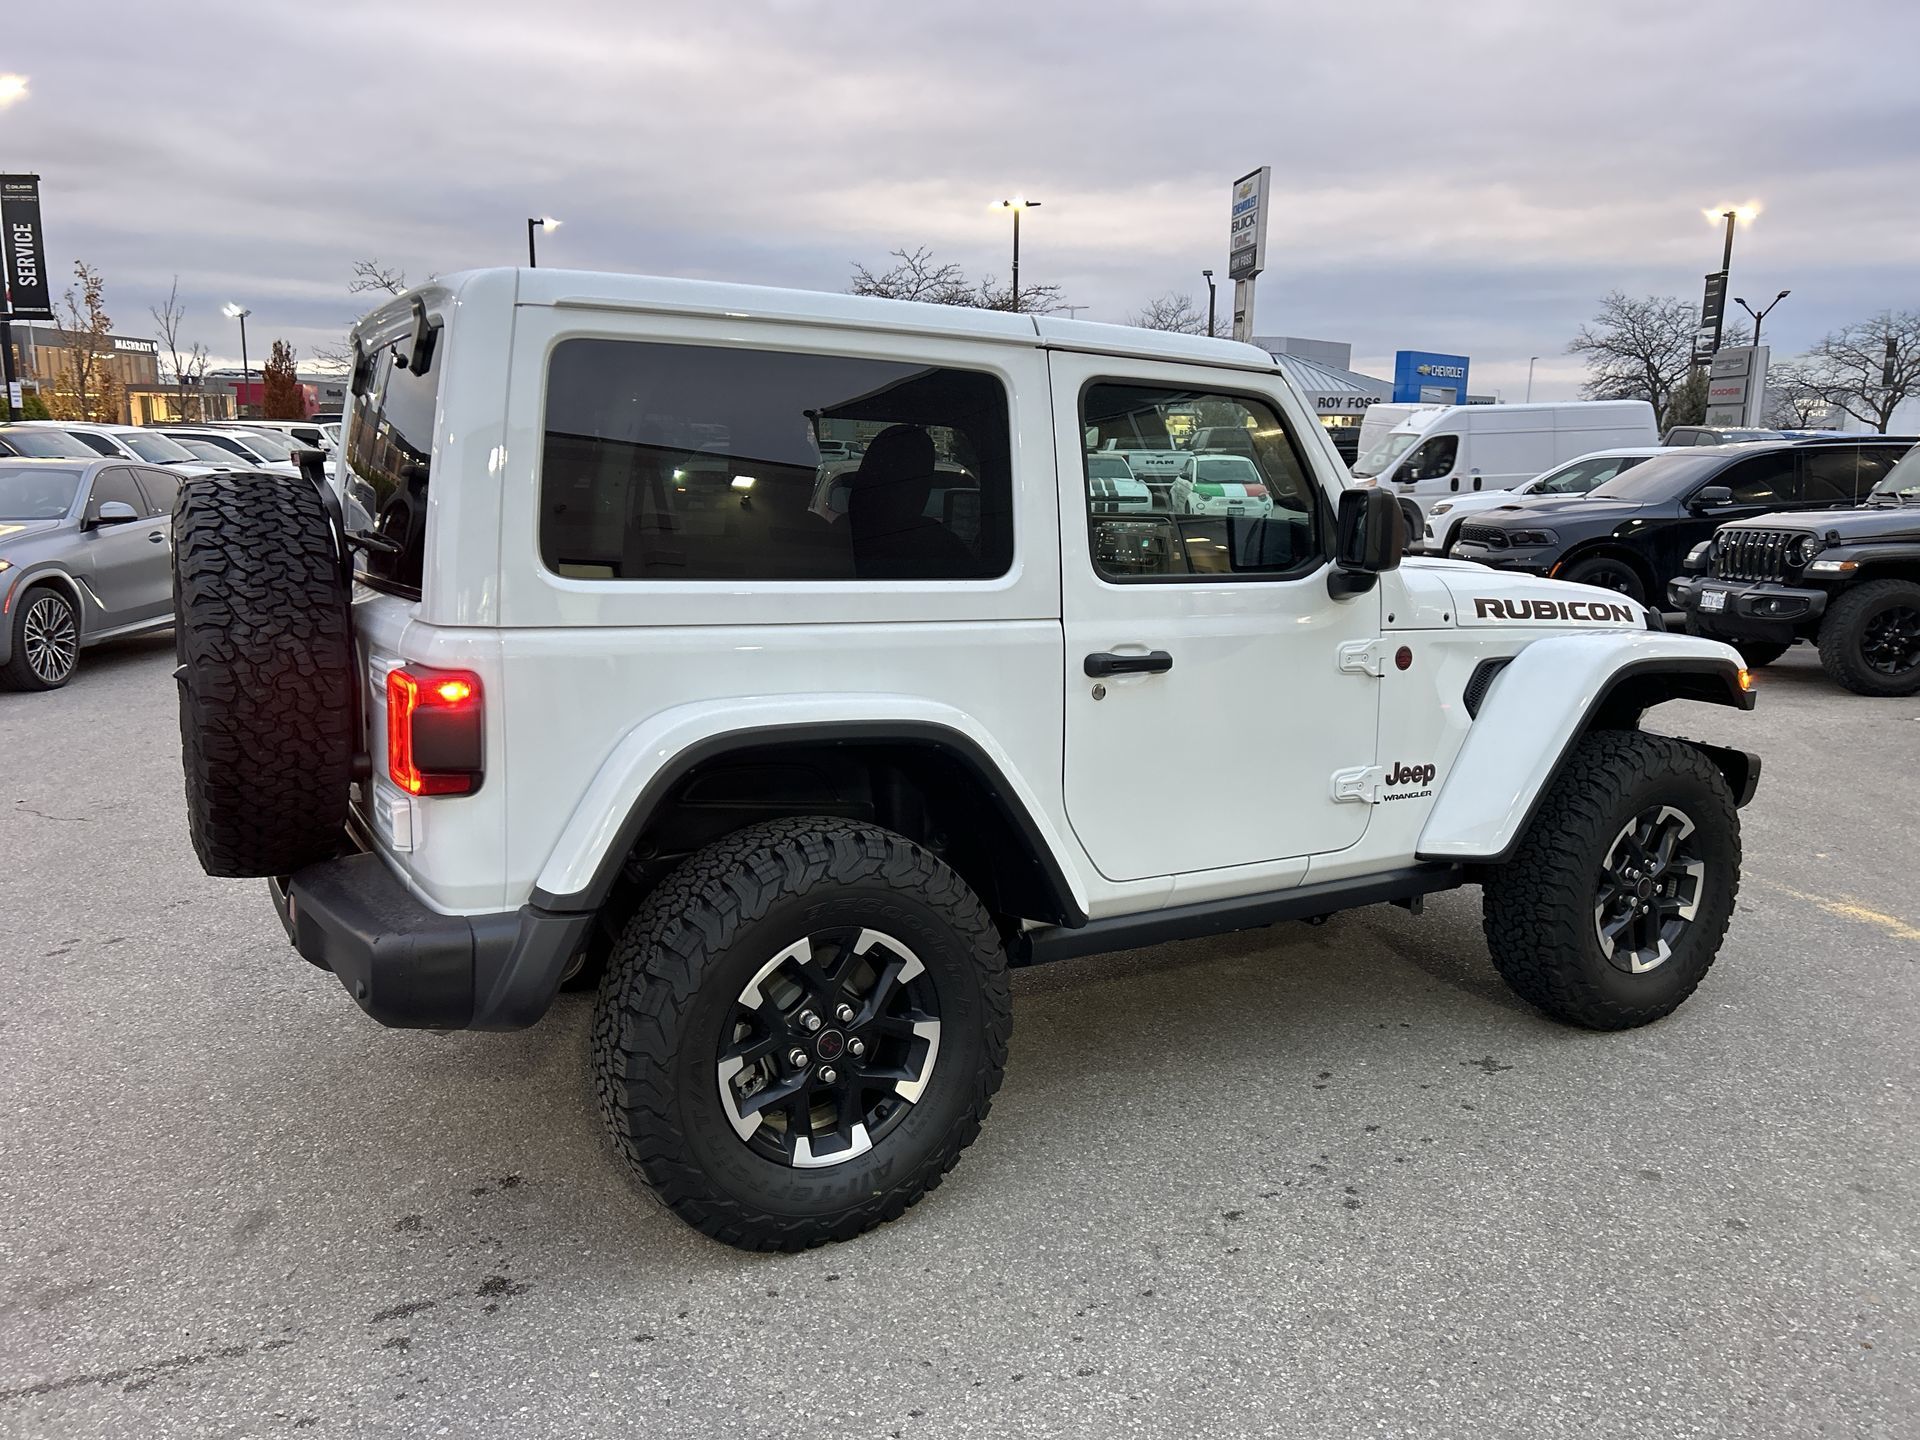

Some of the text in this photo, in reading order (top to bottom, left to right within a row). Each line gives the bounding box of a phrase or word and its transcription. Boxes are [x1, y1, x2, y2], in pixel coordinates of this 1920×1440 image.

[1233, 195, 1257, 216] CHEVROLET
[1232, 212, 1256, 233] BUICK
[1235, 232, 1251, 249] GMC
[13, 223, 38, 287] SERVICE
[1231, 252, 1252, 270] ROY FOSS
[114, 339, 152, 352] MASERATI
[1431, 364, 1465, 378] CHEVROLET
[1711, 387, 1741, 396] DODGE
[1317, 397, 1343, 409] ROY
[1473, 598, 1635, 623] RUBICON
[1385, 761, 1436, 787] Jeep
[1383, 790, 1432, 802] WRANGLER
